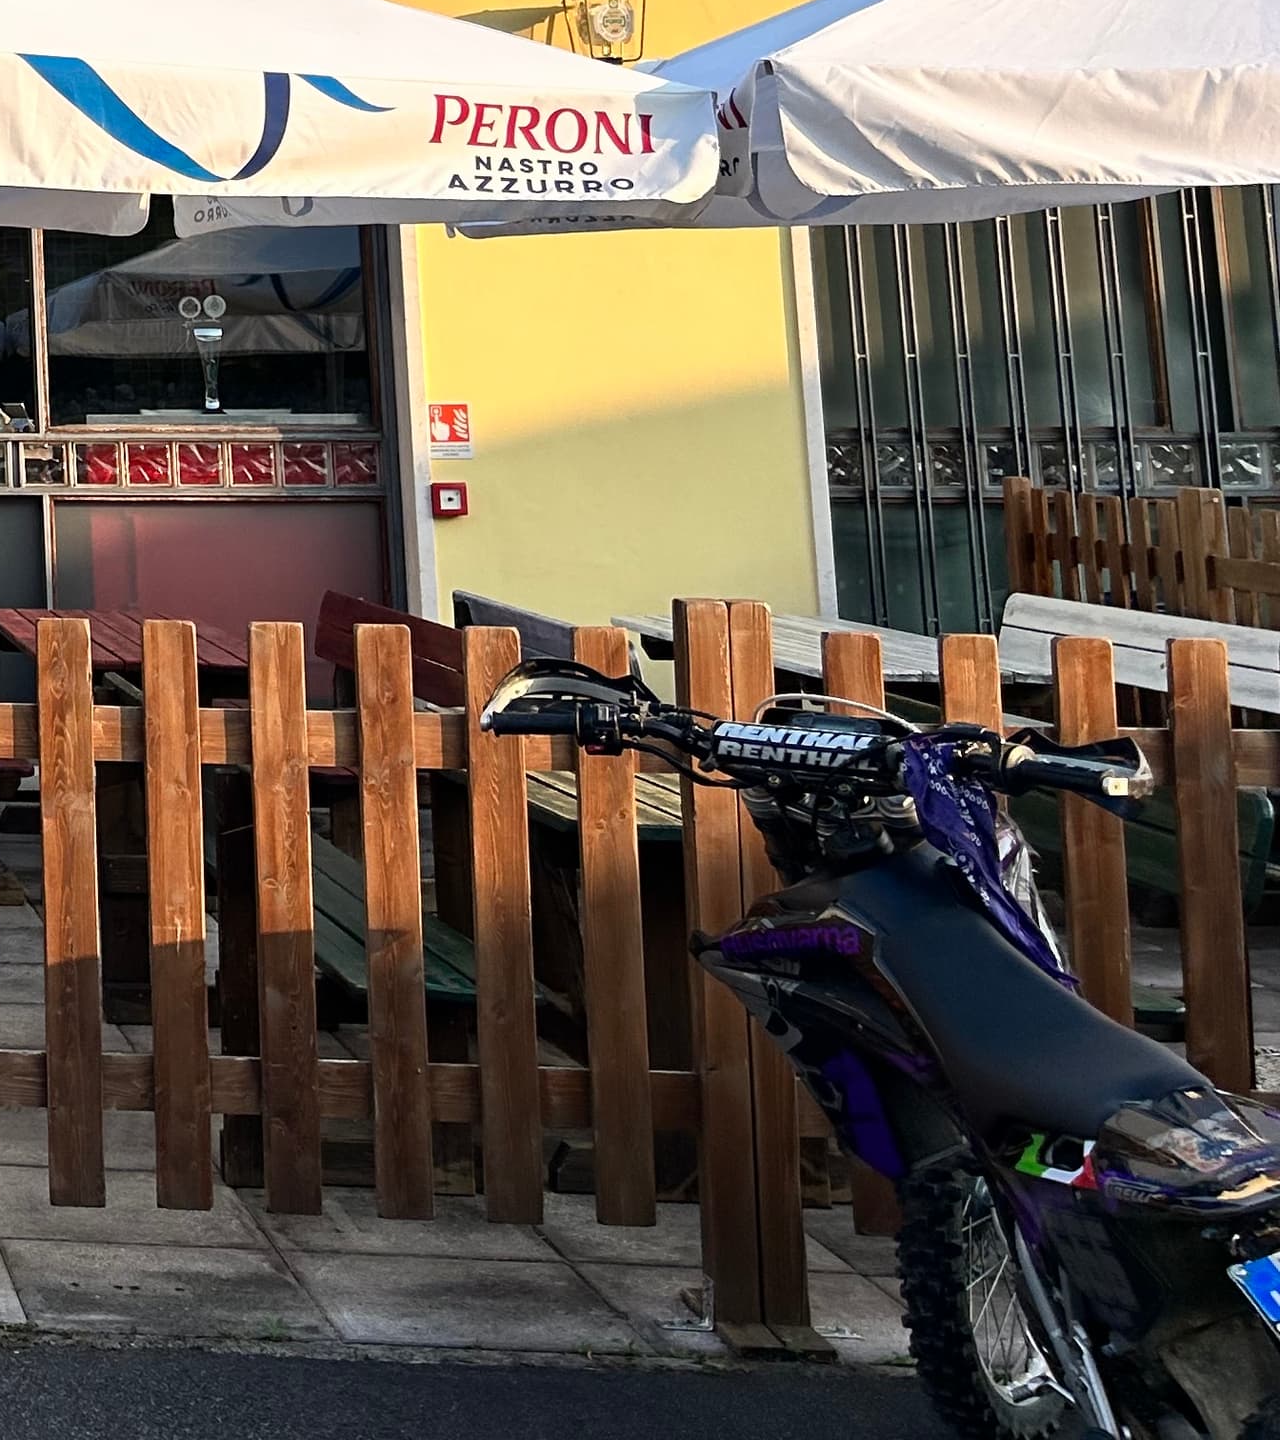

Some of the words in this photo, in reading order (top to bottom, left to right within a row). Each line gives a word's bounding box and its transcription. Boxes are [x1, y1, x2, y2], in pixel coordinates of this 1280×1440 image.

[428, 93, 657, 155] PERONI
[475, 155, 599, 175] NASTRO
[448, 174, 635, 194] AZZURRO
[714, 722, 874, 751] RENTHAL
